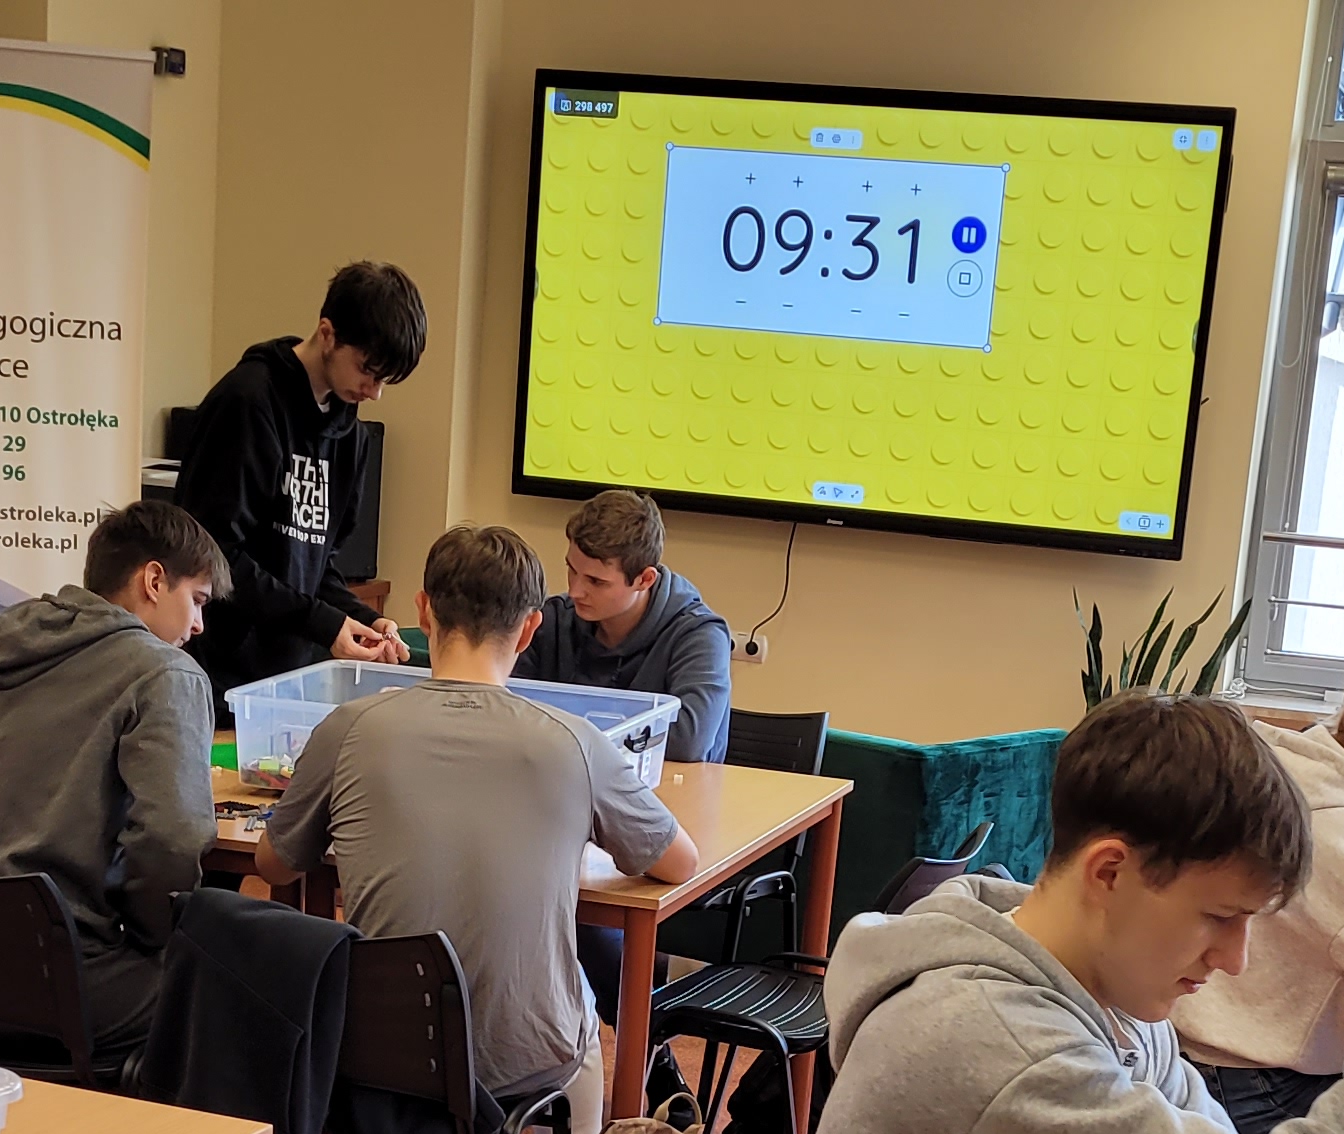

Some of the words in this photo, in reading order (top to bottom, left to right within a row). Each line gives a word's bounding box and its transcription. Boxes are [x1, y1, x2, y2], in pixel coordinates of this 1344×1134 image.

[594, 102, 614, 114] 497
[722, 205, 921, 285] 09:31
[26, 406, 119, 432] Ostrołęka
[2, 435, 26, 452] 29
[2, 464, 26, 481] 96
[281, 471, 324, 506] NRTH
[292, 499, 324, 530] ACE
